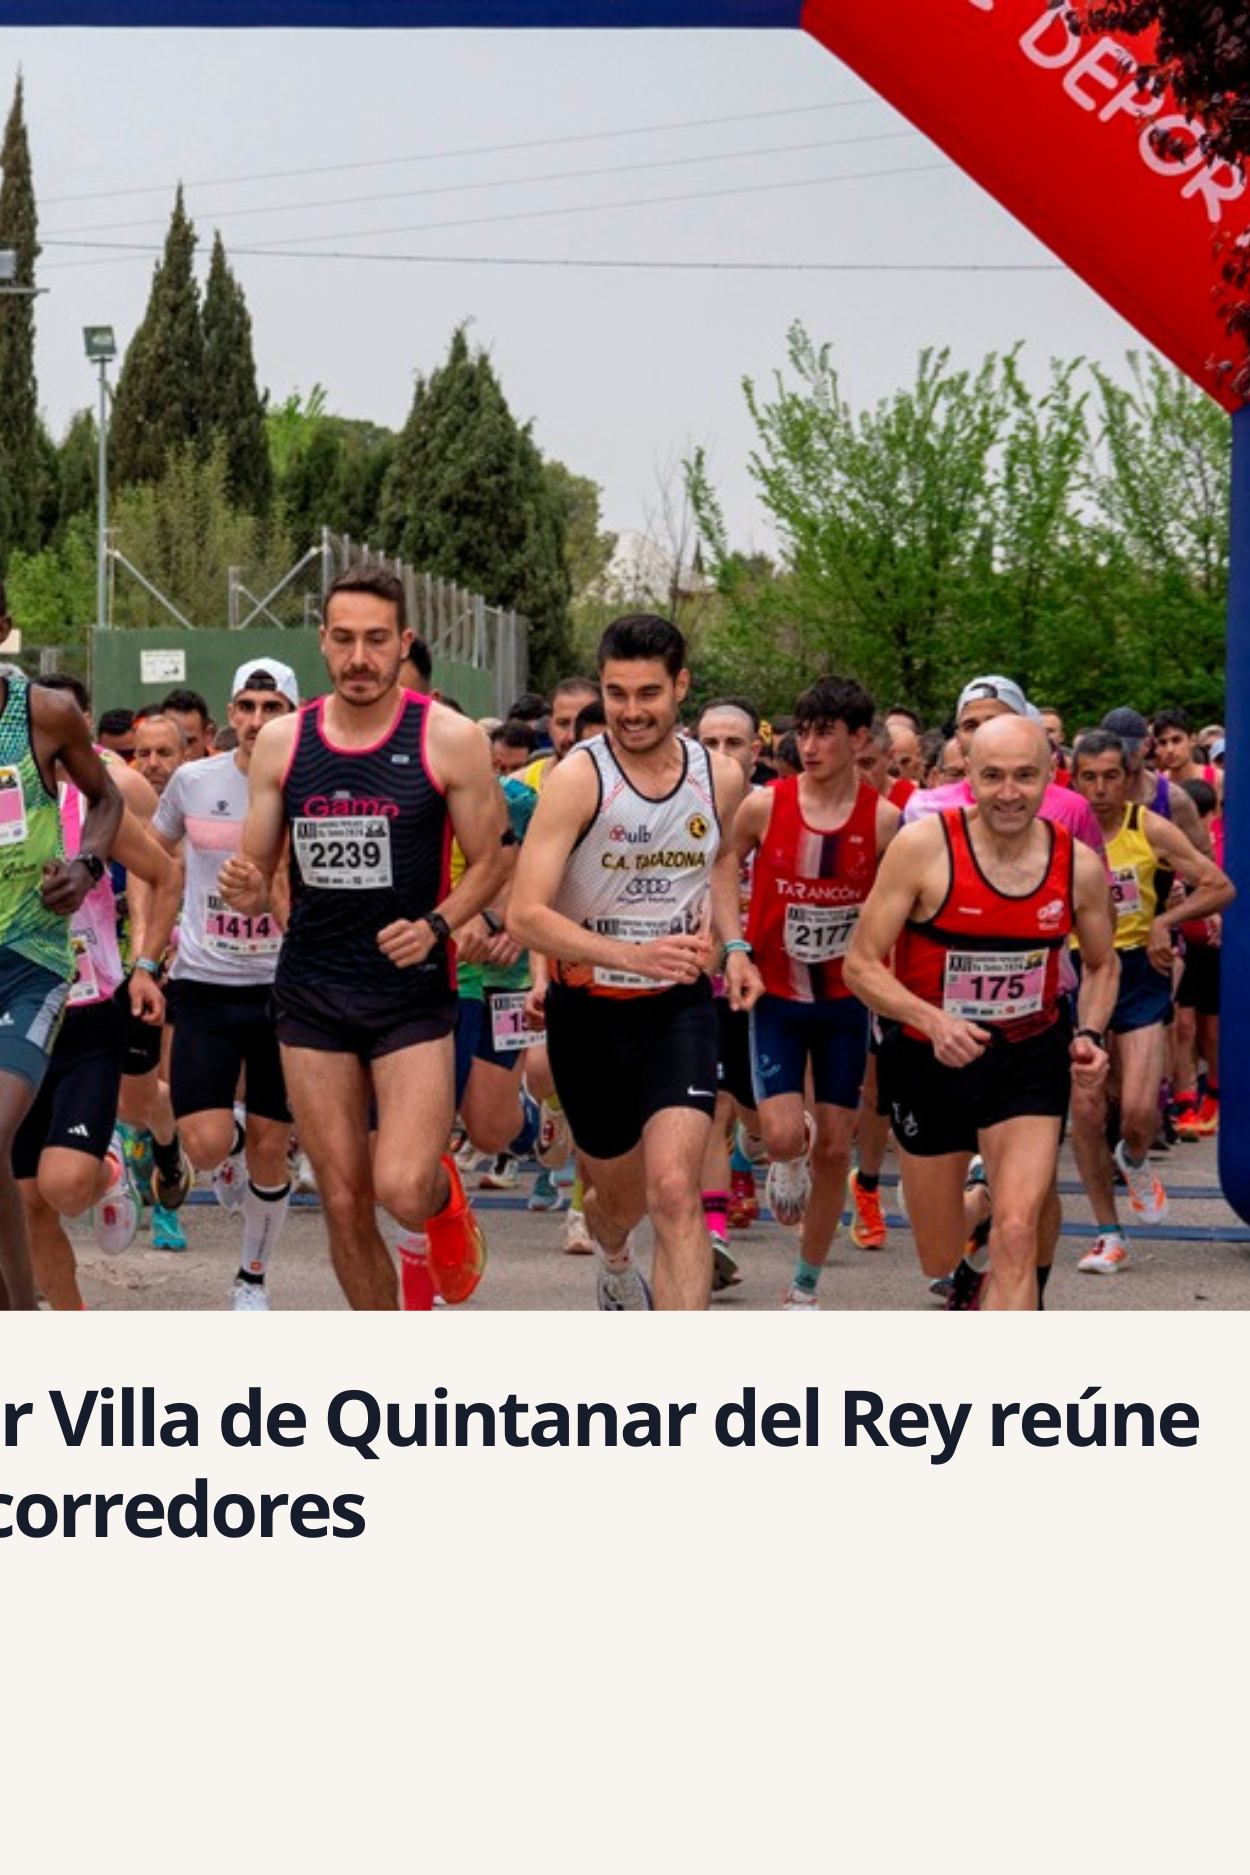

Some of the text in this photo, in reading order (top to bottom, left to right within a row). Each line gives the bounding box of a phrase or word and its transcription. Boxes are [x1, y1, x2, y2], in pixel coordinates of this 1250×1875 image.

[1019, 0, 1250, 248] DEPOR
[309, 842, 381, 868] 2239
[216, 914, 270, 938] 1414
[795, 922, 853, 948] 2177
[970, 974, 1025, 1000] 175
